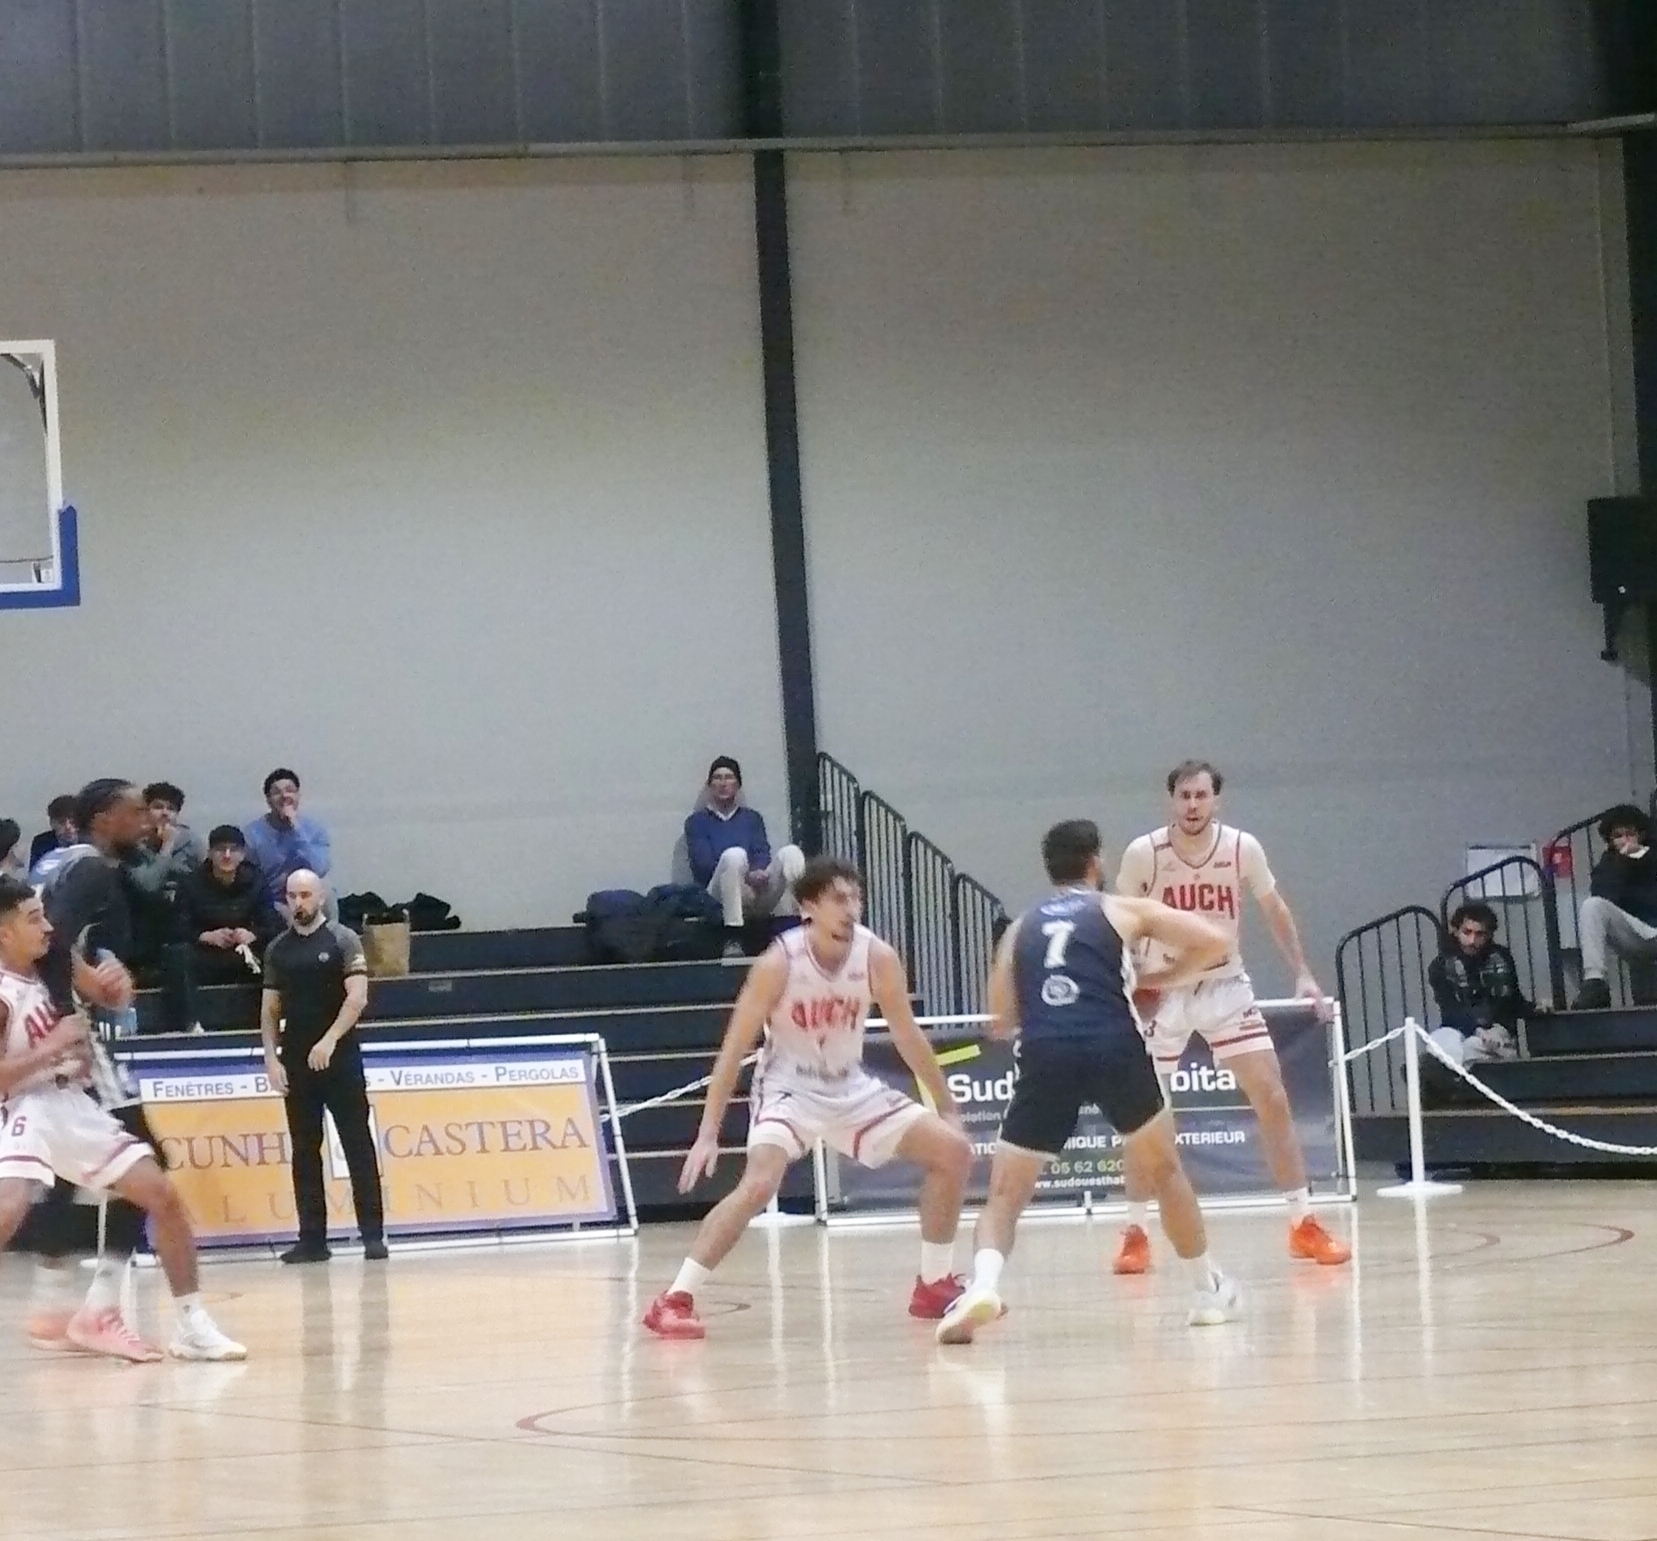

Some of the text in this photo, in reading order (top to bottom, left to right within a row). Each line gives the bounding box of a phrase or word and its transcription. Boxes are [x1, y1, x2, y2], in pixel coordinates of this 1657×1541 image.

[1162, 883, 1235, 920] AUCH
[1041, 919, 1077, 969] 7
[495, 1065, 579, 1082] PERGOLAS
[11, 1116, 26, 1137] 6
[1175, 1131, 1246, 1145] XTERIEUR
[161, 1117, 591, 1172] CUNH CASTERA
